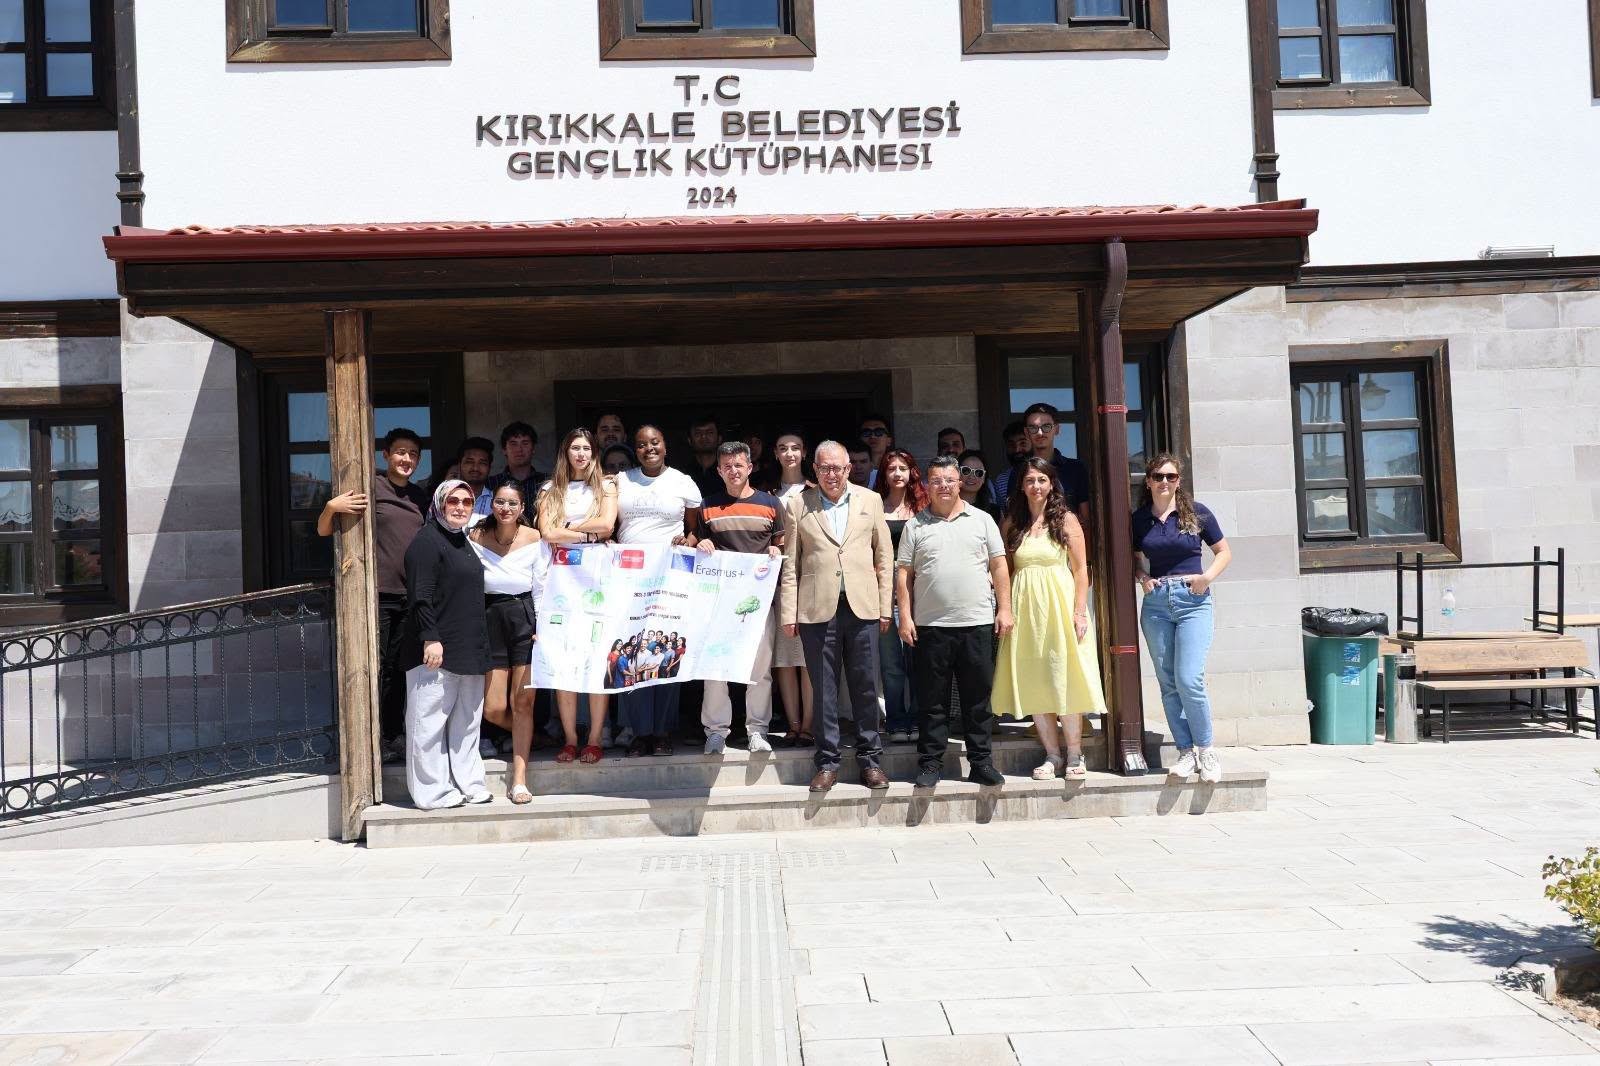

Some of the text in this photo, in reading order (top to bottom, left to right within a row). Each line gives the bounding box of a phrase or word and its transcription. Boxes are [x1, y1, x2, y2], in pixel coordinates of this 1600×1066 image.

[674, 74, 741, 101] T.C
[475, 111, 696, 141] KIRIKKALE
[686, 186, 738, 204] 2024
[695, 564, 745, 578] Erasmus+
